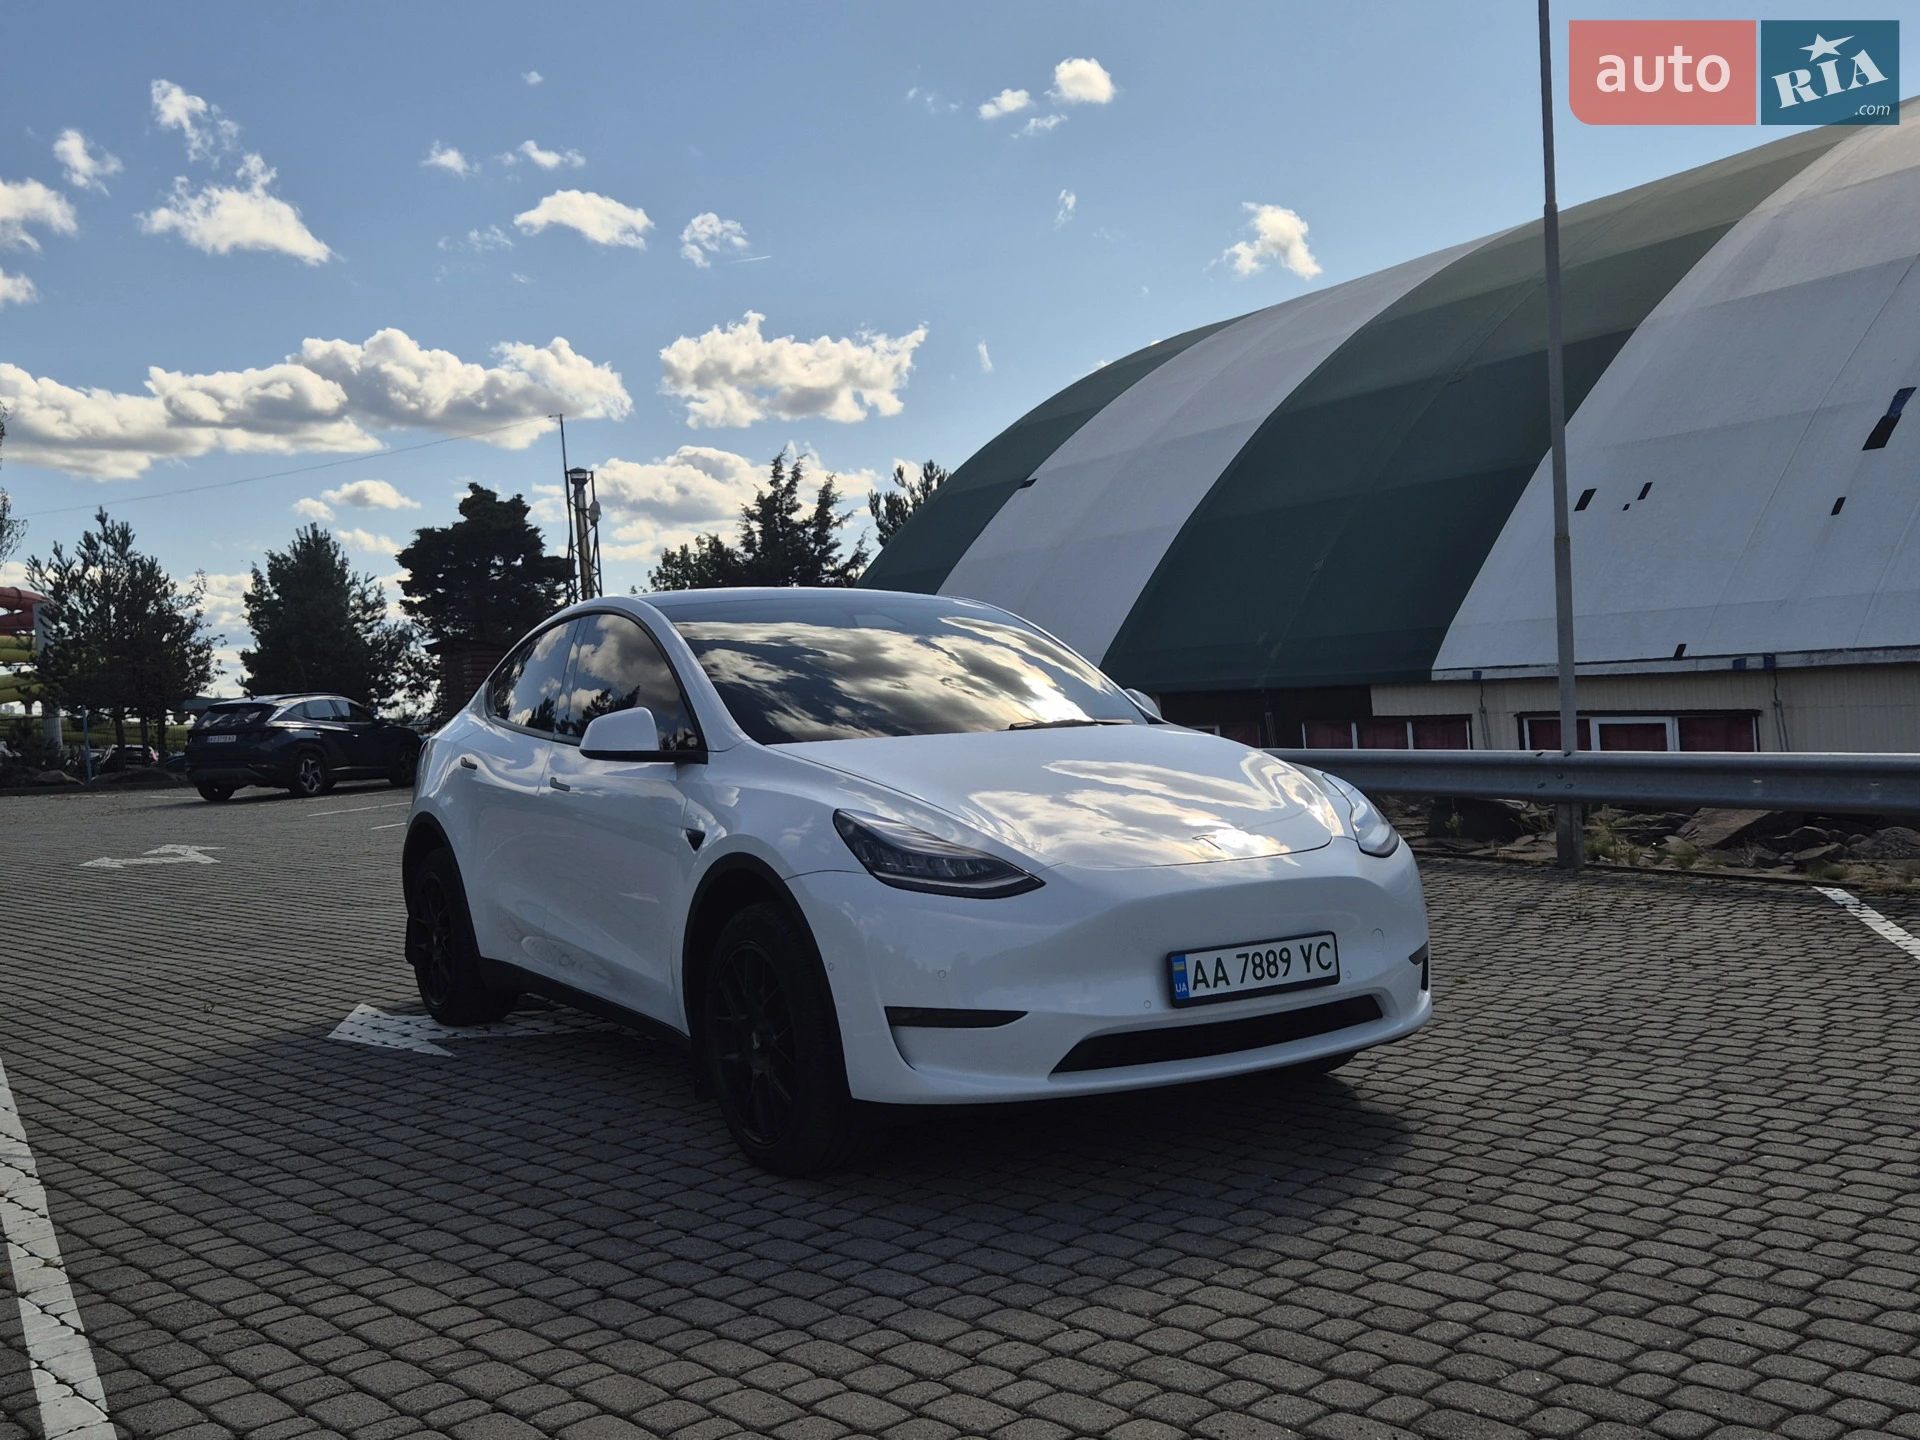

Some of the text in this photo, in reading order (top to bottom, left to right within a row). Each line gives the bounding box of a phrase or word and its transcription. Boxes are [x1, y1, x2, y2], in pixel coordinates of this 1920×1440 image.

[1192, 941, 1333, 991] AA 7889 YC
[1175, 983, 1187, 993] UA
